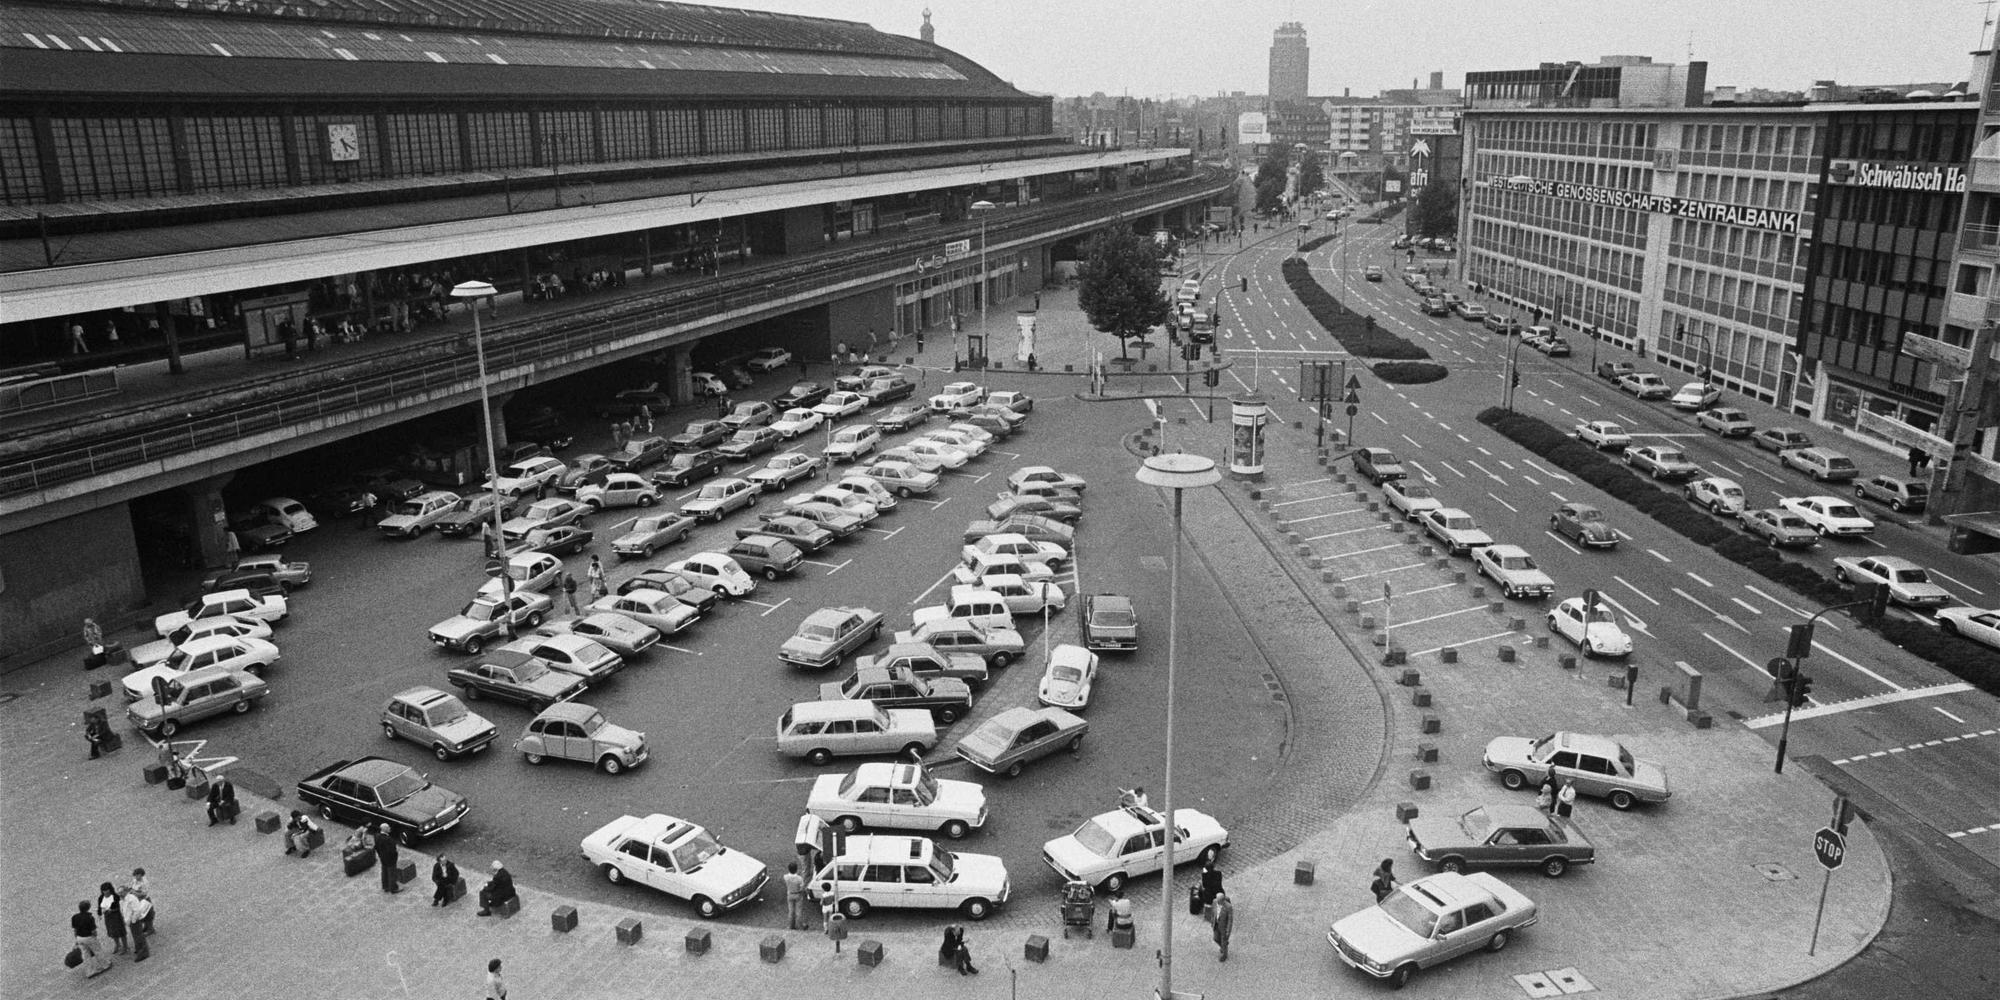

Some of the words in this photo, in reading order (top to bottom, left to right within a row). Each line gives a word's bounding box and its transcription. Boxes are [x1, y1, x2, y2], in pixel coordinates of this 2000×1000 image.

[1410, 168, 1428, 186] afri
[1487, 175, 1553, 195] WESTDEUTSCHE
[1859, 163, 1942, 191] Schwäbisch
[1816, 836, 1842, 861] STOP
